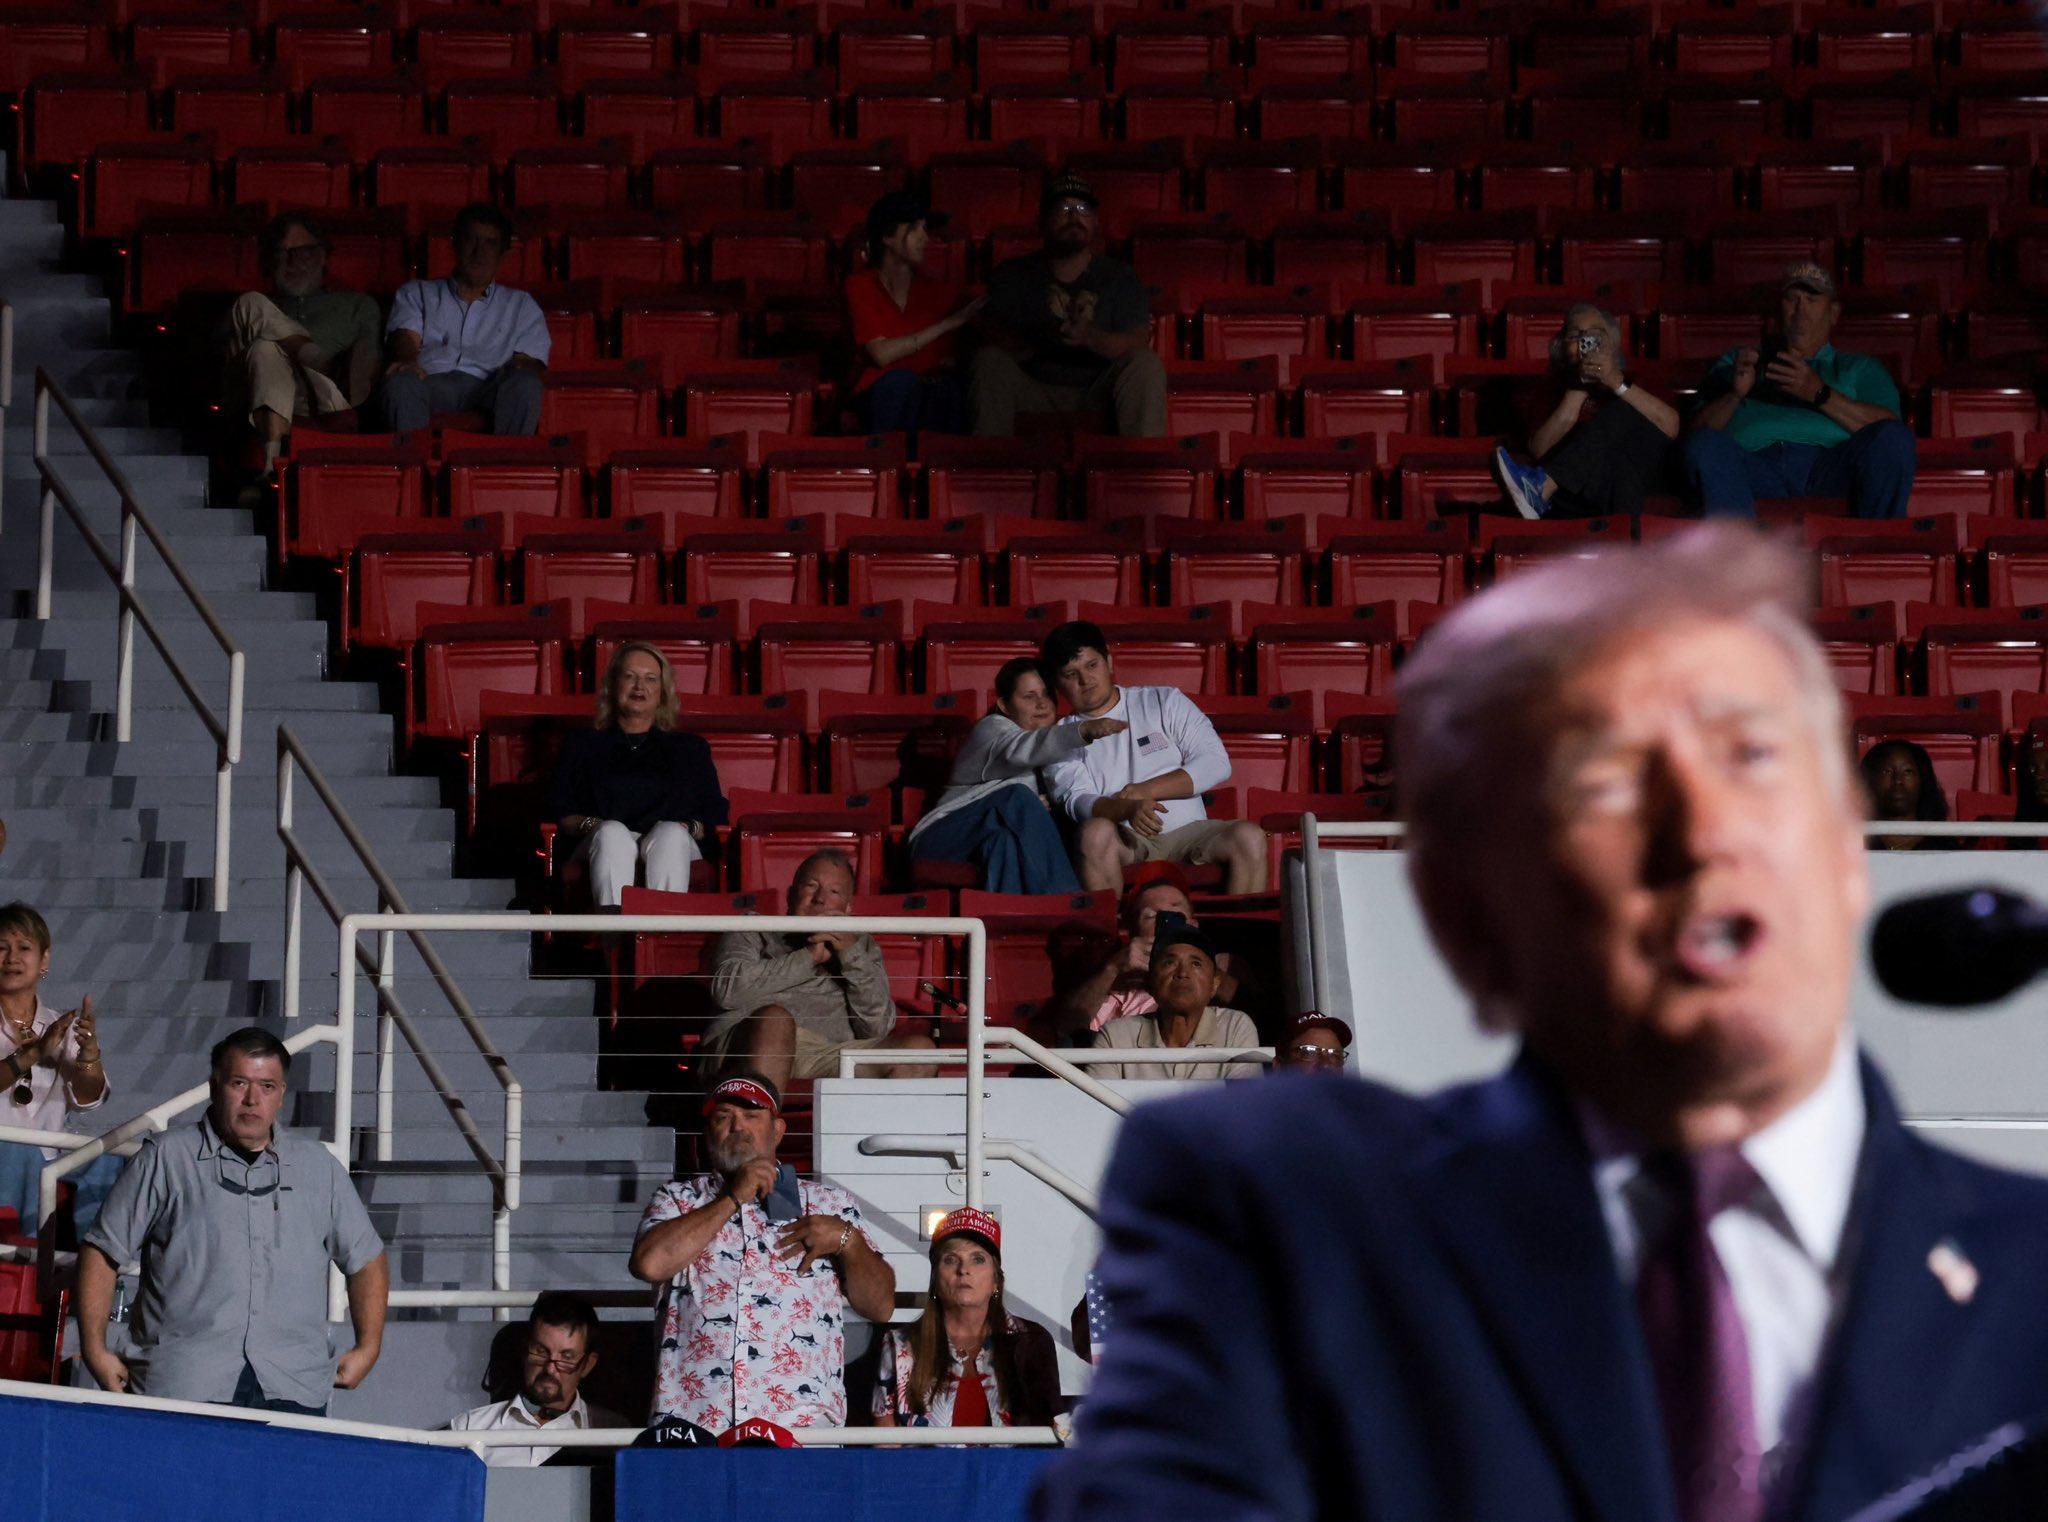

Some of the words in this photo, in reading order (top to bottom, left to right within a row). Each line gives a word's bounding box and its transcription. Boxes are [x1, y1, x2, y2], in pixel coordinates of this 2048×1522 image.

[968, 1218, 996, 1234] ABOUT
[655, 1427, 697, 1444] USA
[735, 1425, 776, 1441] USA
